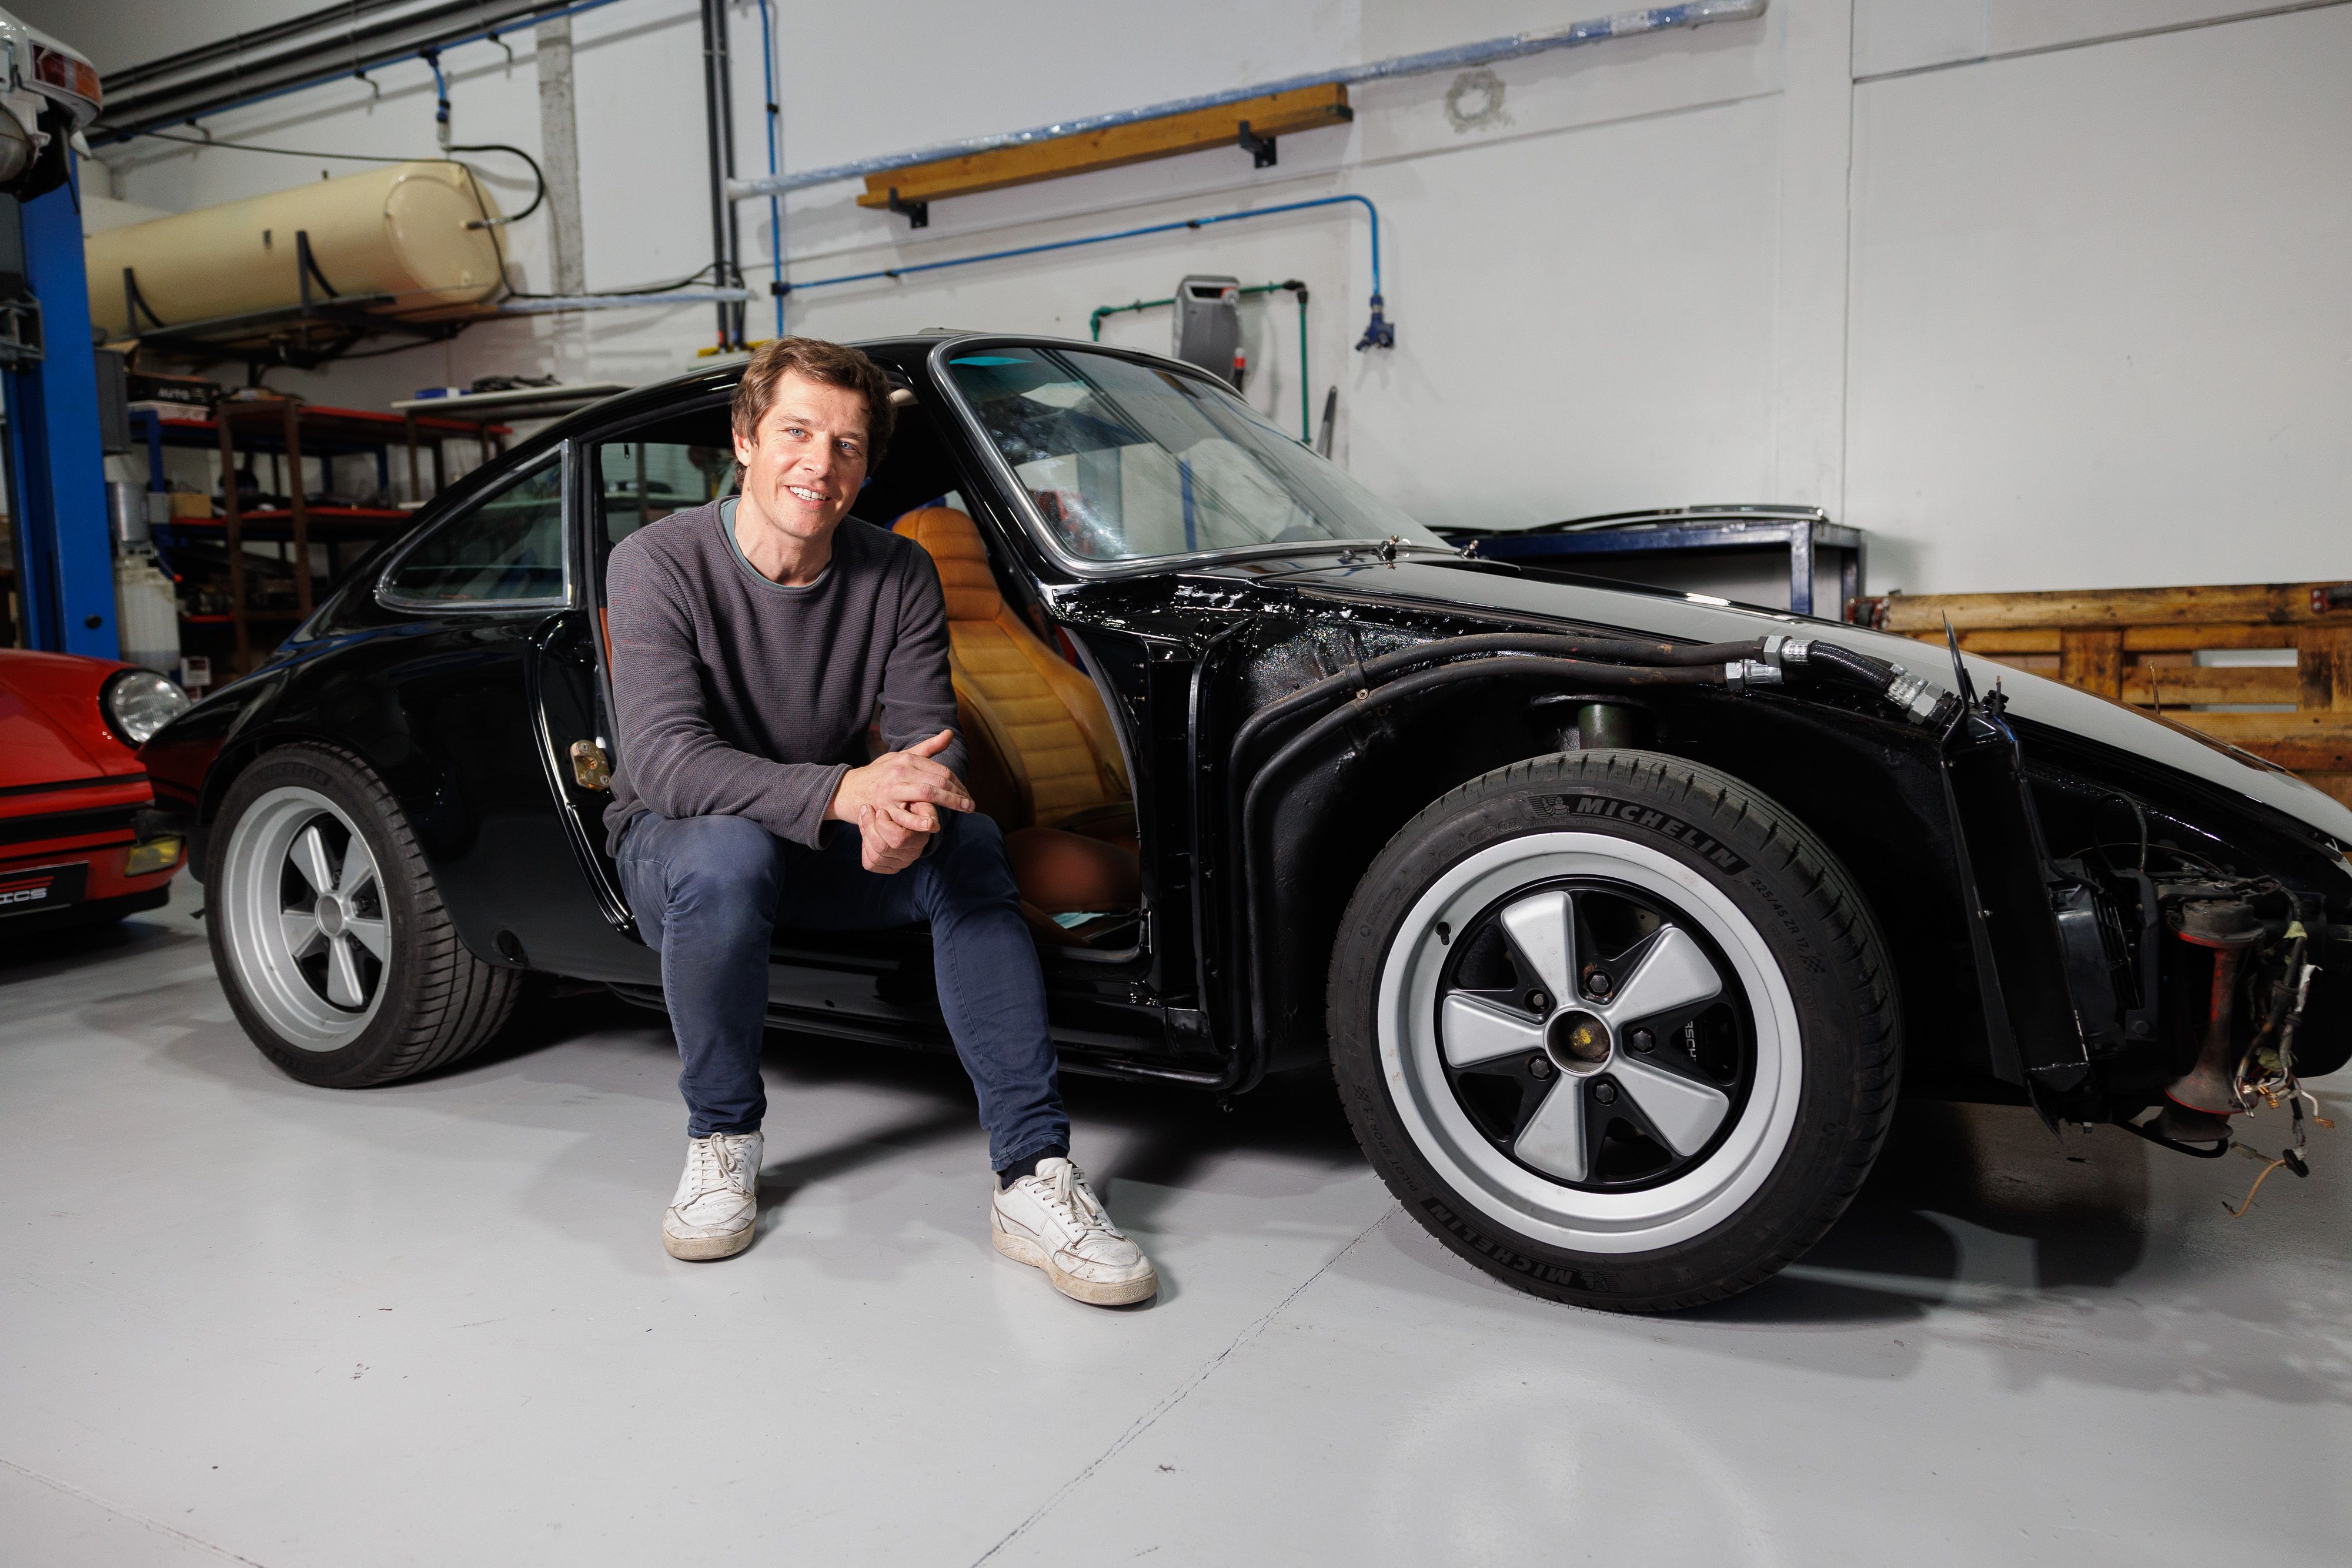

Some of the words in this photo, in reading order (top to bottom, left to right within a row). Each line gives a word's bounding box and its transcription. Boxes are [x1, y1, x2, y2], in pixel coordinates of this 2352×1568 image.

[1576, 797, 1739, 868] MICHELIN
[1750, 878, 1789, 917] 225/45
[1783, 919, 1800, 935] ZR
[1796, 937, 1810, 949] 17
[1389, 1159, 1418, 1192] PILOT
[1429, 1205, 1572, 1285] MICHELIN
